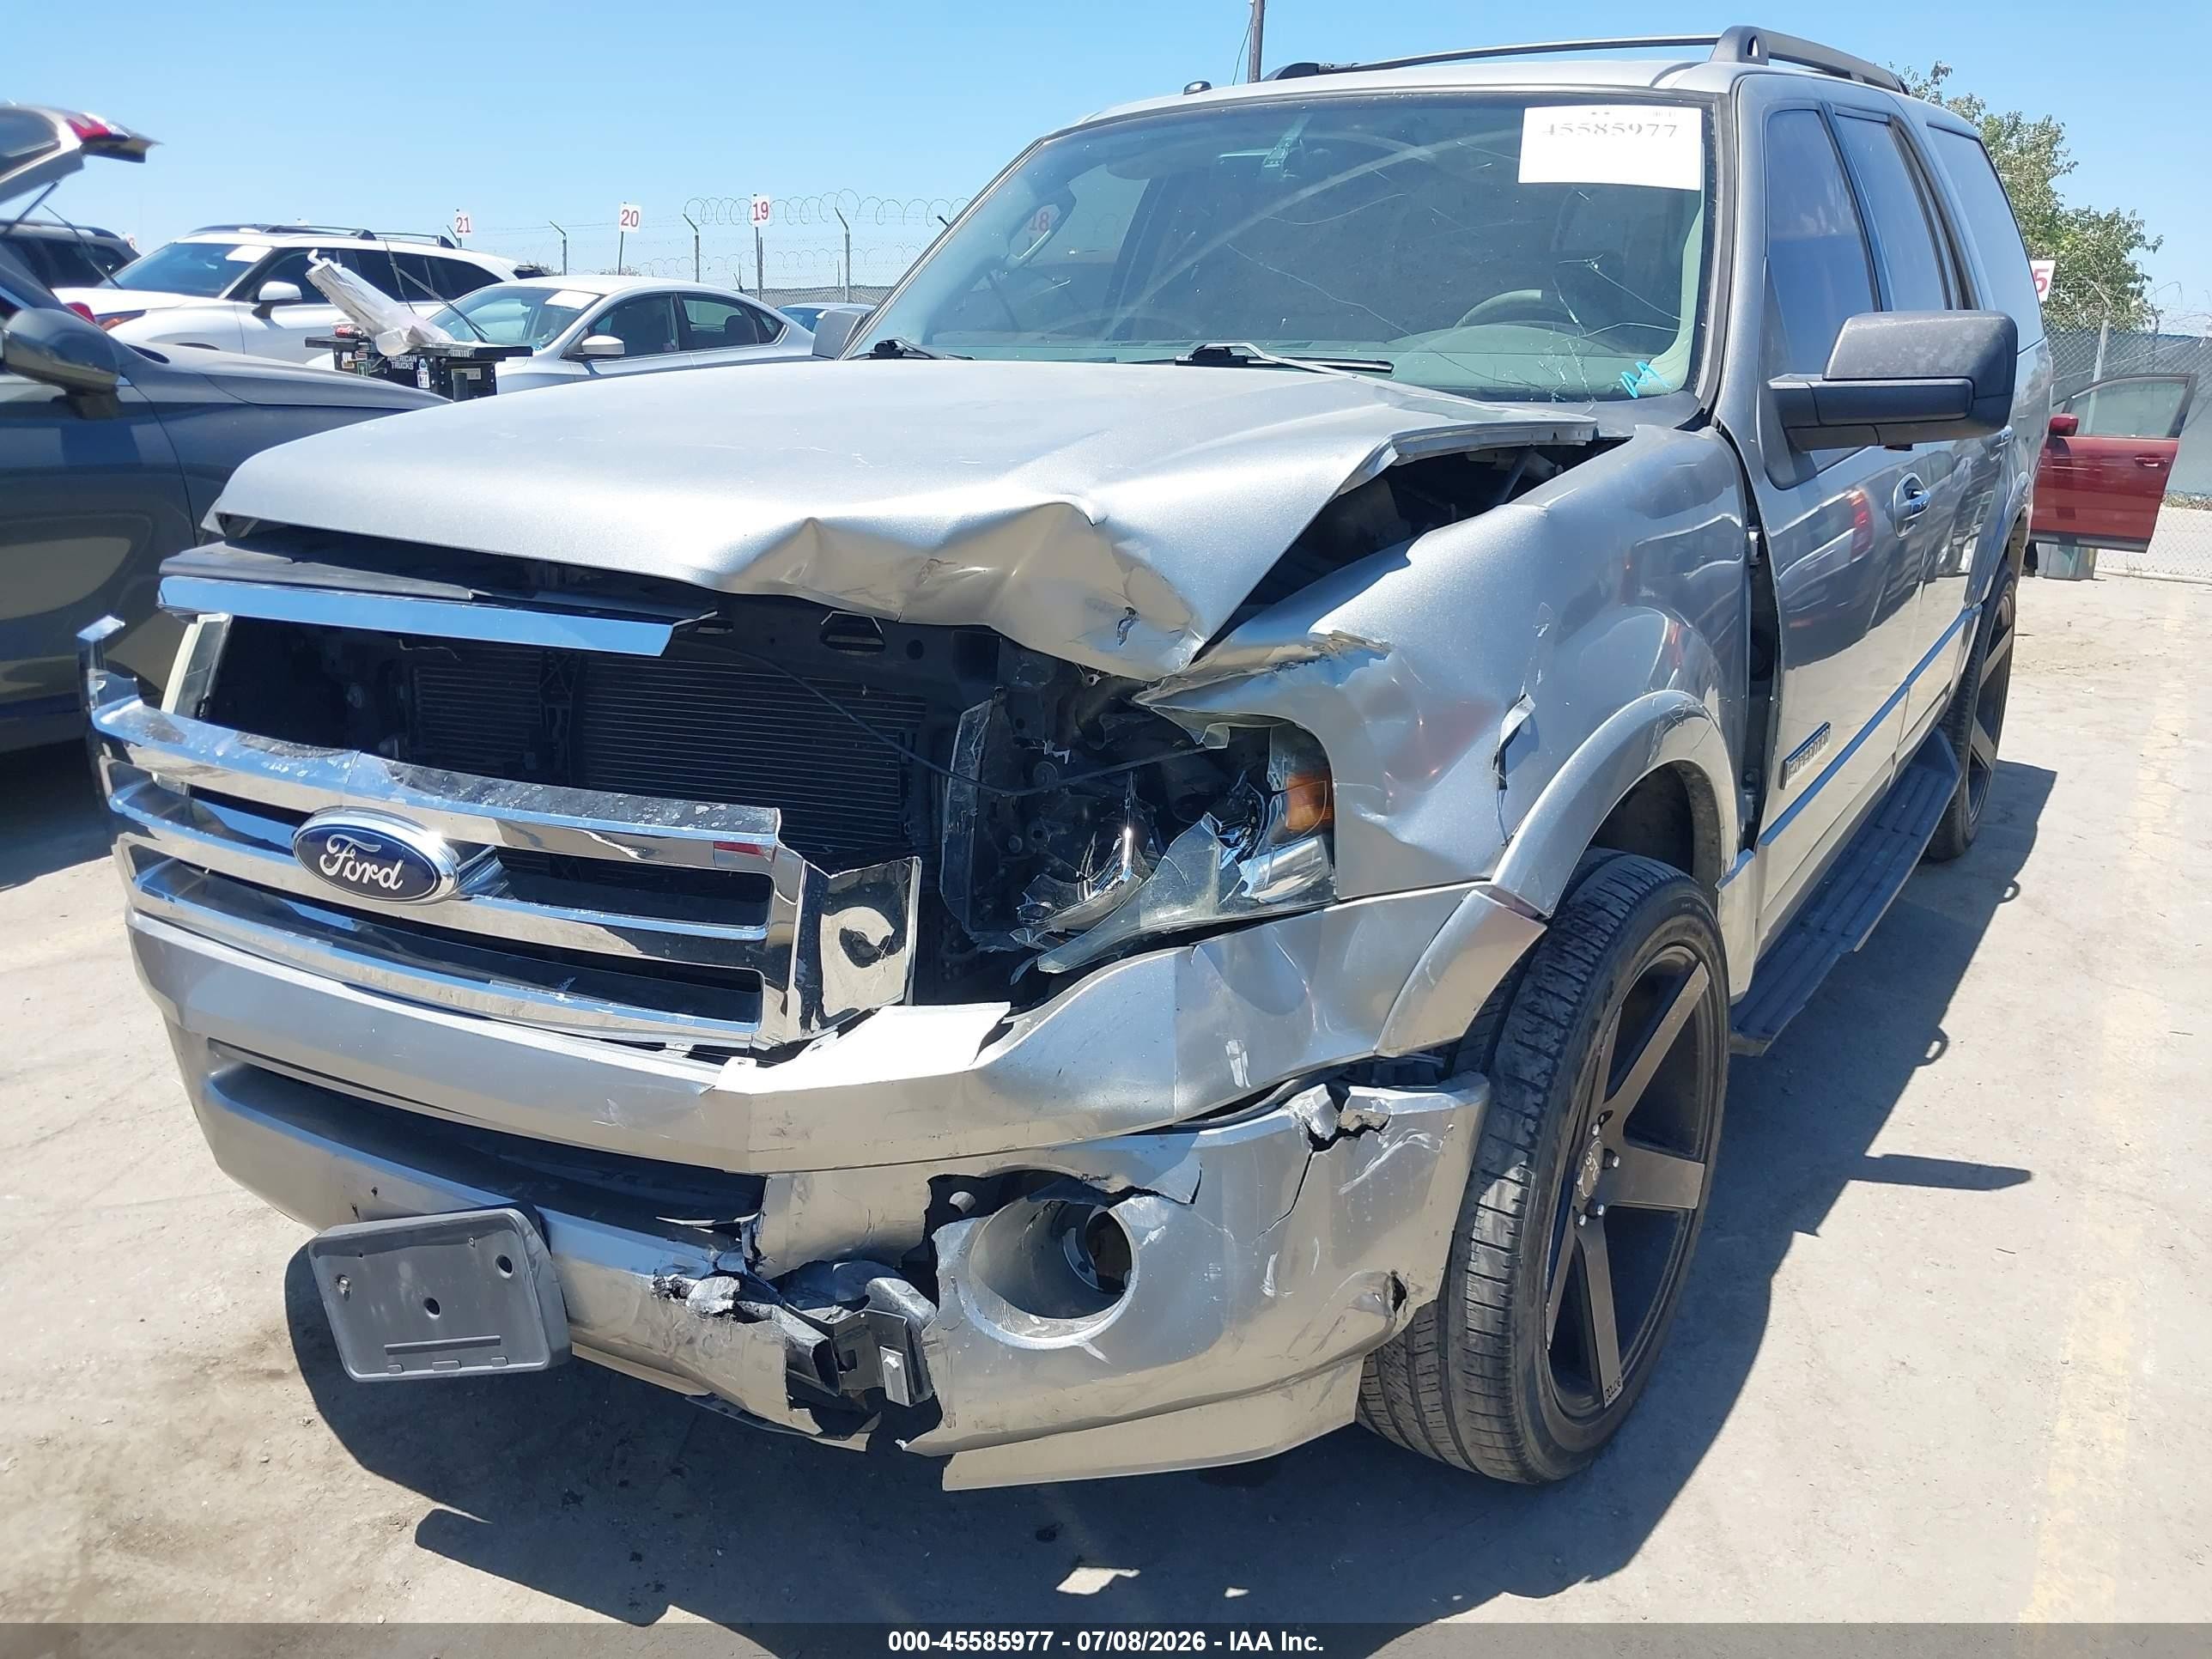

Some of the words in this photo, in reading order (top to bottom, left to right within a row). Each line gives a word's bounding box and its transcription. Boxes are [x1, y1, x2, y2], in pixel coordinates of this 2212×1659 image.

[1542, 123, 1680, 138] 45585977
[620, 209, 641, 228] 20
[751, 201, 770, 221] 19
[455, 216, 472, 234] 21
[1029, 211, 1050, 233] 18
[391, 362, 415, 370] TRUCKS
[319, 833, 404, 890] Ford
